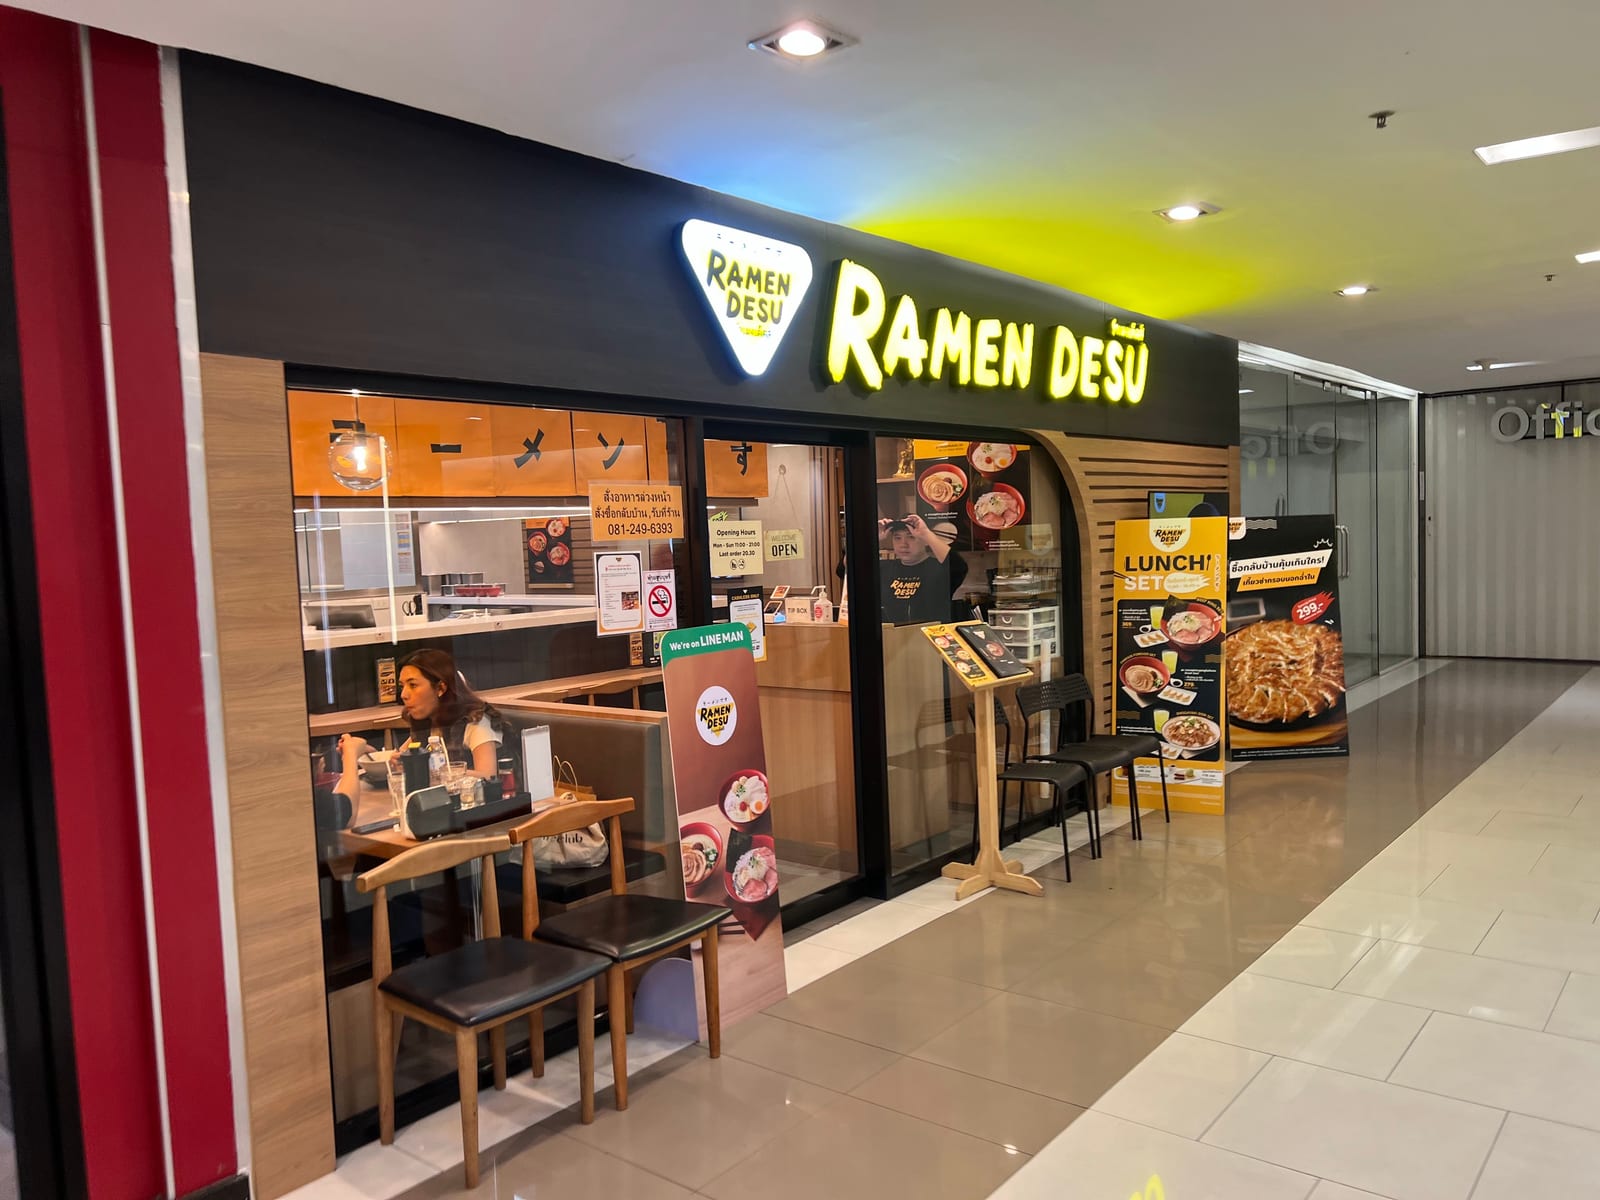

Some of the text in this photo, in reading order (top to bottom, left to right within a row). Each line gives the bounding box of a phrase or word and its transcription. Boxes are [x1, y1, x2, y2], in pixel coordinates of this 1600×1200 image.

[706, 248, 791, 297] RAMEN
[726, 291, 783, 325] DESU
[827, 257, 1149, 404] RAMEN DESU
[608, 523, 673, 536] 081-249-6393
[716, 529, 740, 537] Opening
[1155, 529, 1183, 538] RAMEN
[772, 544, 798, 557] OPEN
[1125, 554, 1205, 572] LUNCH
[890, 579, 921, 590] RAMEN
[1124, 575, 1164, 591] SET
[894, 588, 917, 596] DESU
[669, 641, 690, 651] We're
[700, 704, 731, 722] RAMEN
[707, 715, 729, 730] DESU
